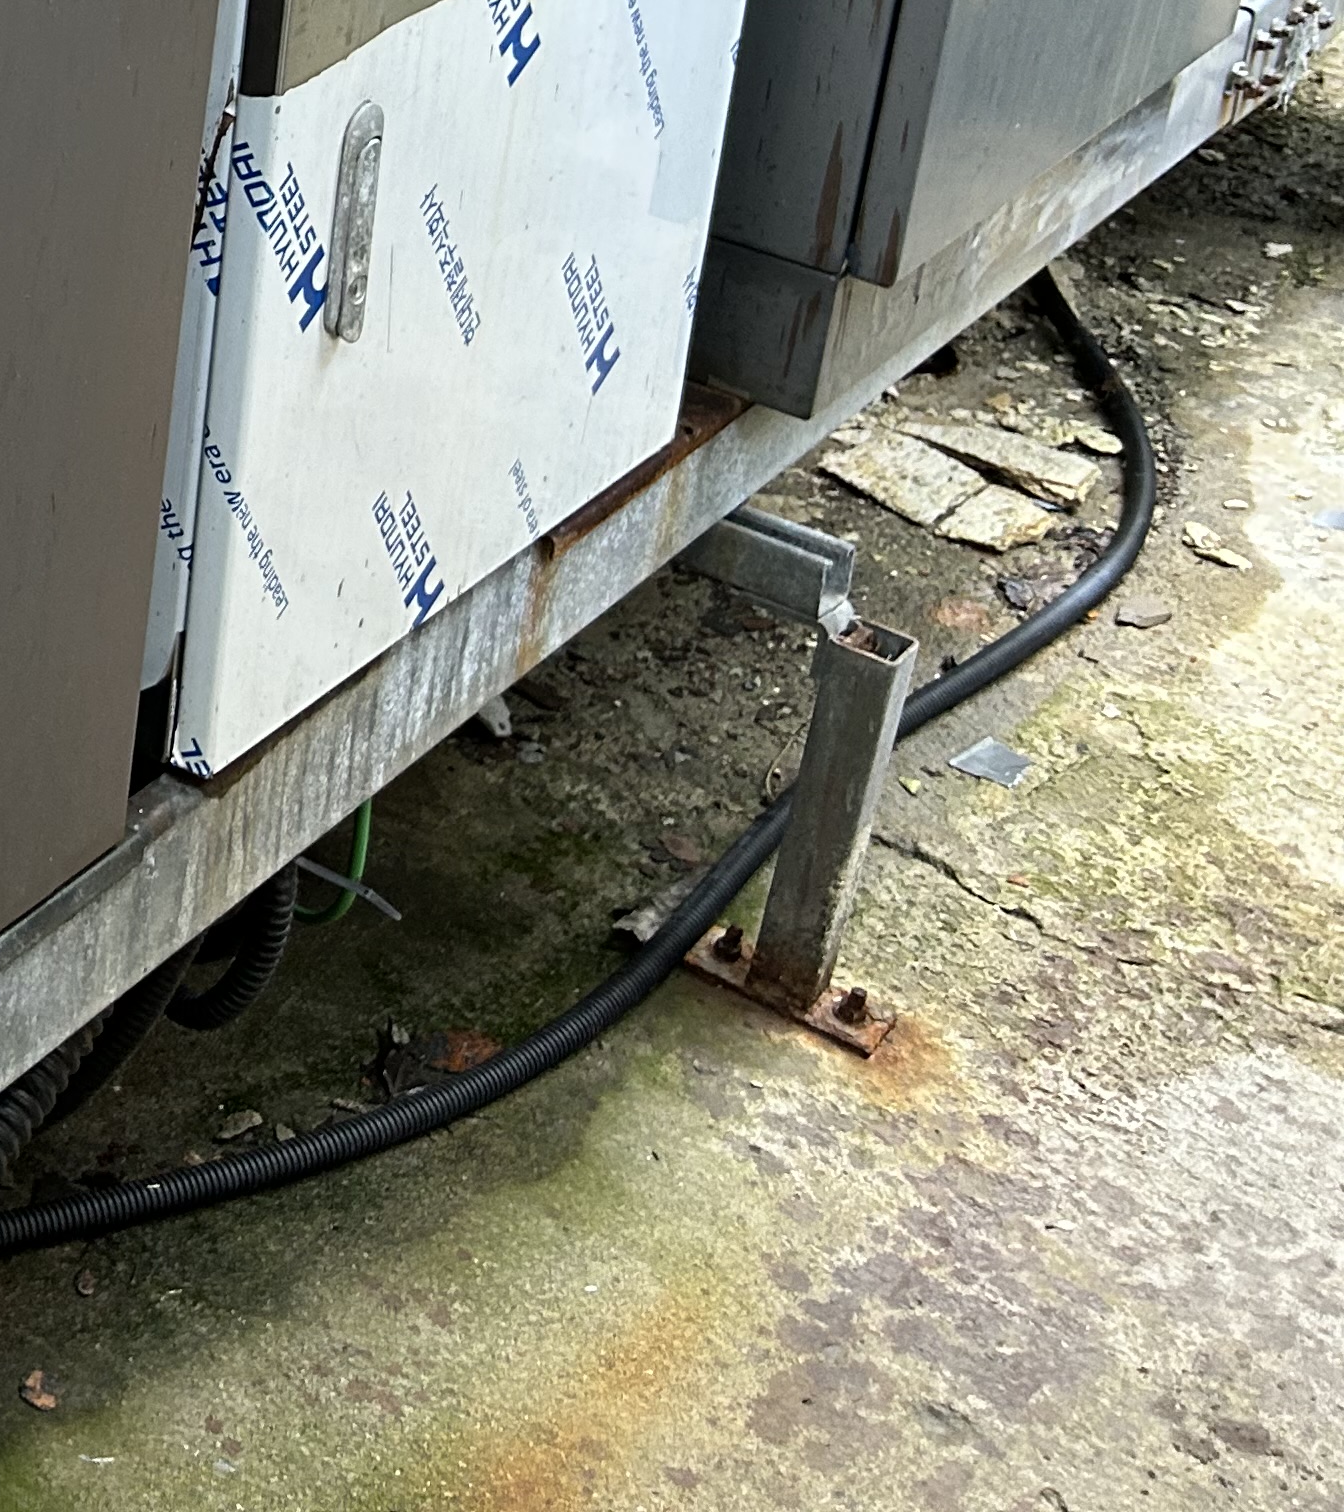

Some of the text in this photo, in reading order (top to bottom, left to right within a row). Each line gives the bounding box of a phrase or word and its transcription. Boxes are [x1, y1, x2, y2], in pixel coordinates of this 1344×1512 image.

[631, 8, 646, 46] new
[639, 42, 651, 76] the
[646, 68, 664, 140] Leading
[232, 142, 300, 283] HYUNDAI
[279, 161, 317, 255] STEEL
[420, 183, 481, 346] 현대제철주식회사
[562, 251, 596, 355] HYUNDAI
[584, 254, 609, 331] STEEL
[508, 458, 528, 496] steel
[204, 444, 290, 620] Leading the new era
[372, 490, 415, 592] HYUNDAI
[399, 490, 430, 567] STEEL
[526, 508, 538, 534] era
